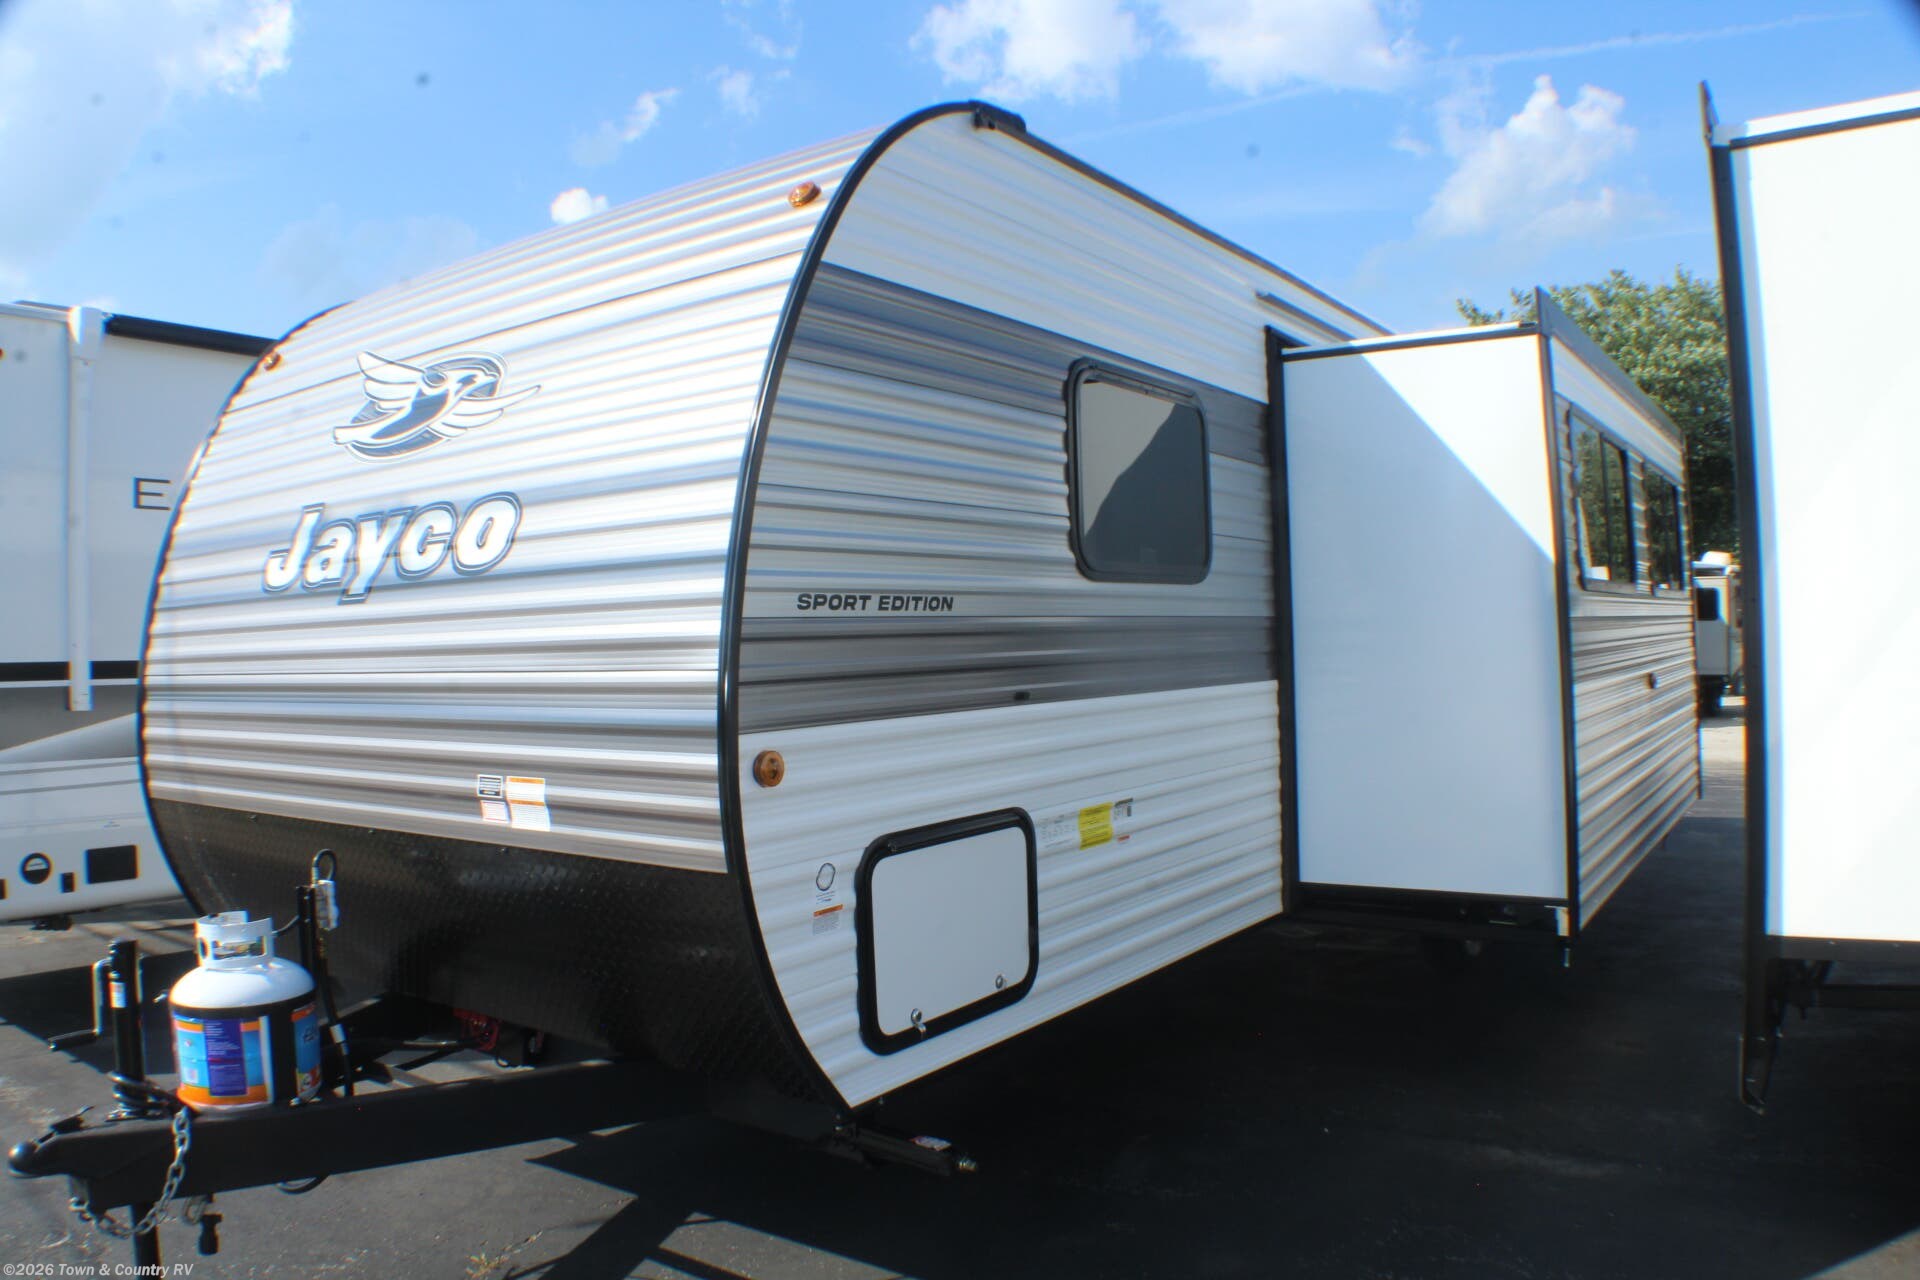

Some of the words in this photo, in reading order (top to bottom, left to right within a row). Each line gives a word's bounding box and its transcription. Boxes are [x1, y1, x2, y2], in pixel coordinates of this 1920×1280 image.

[262, 491, 523, 605] Jayco
[796, 593, 872, 611] SPORT
[877, 595, 954, 612] EDITION
